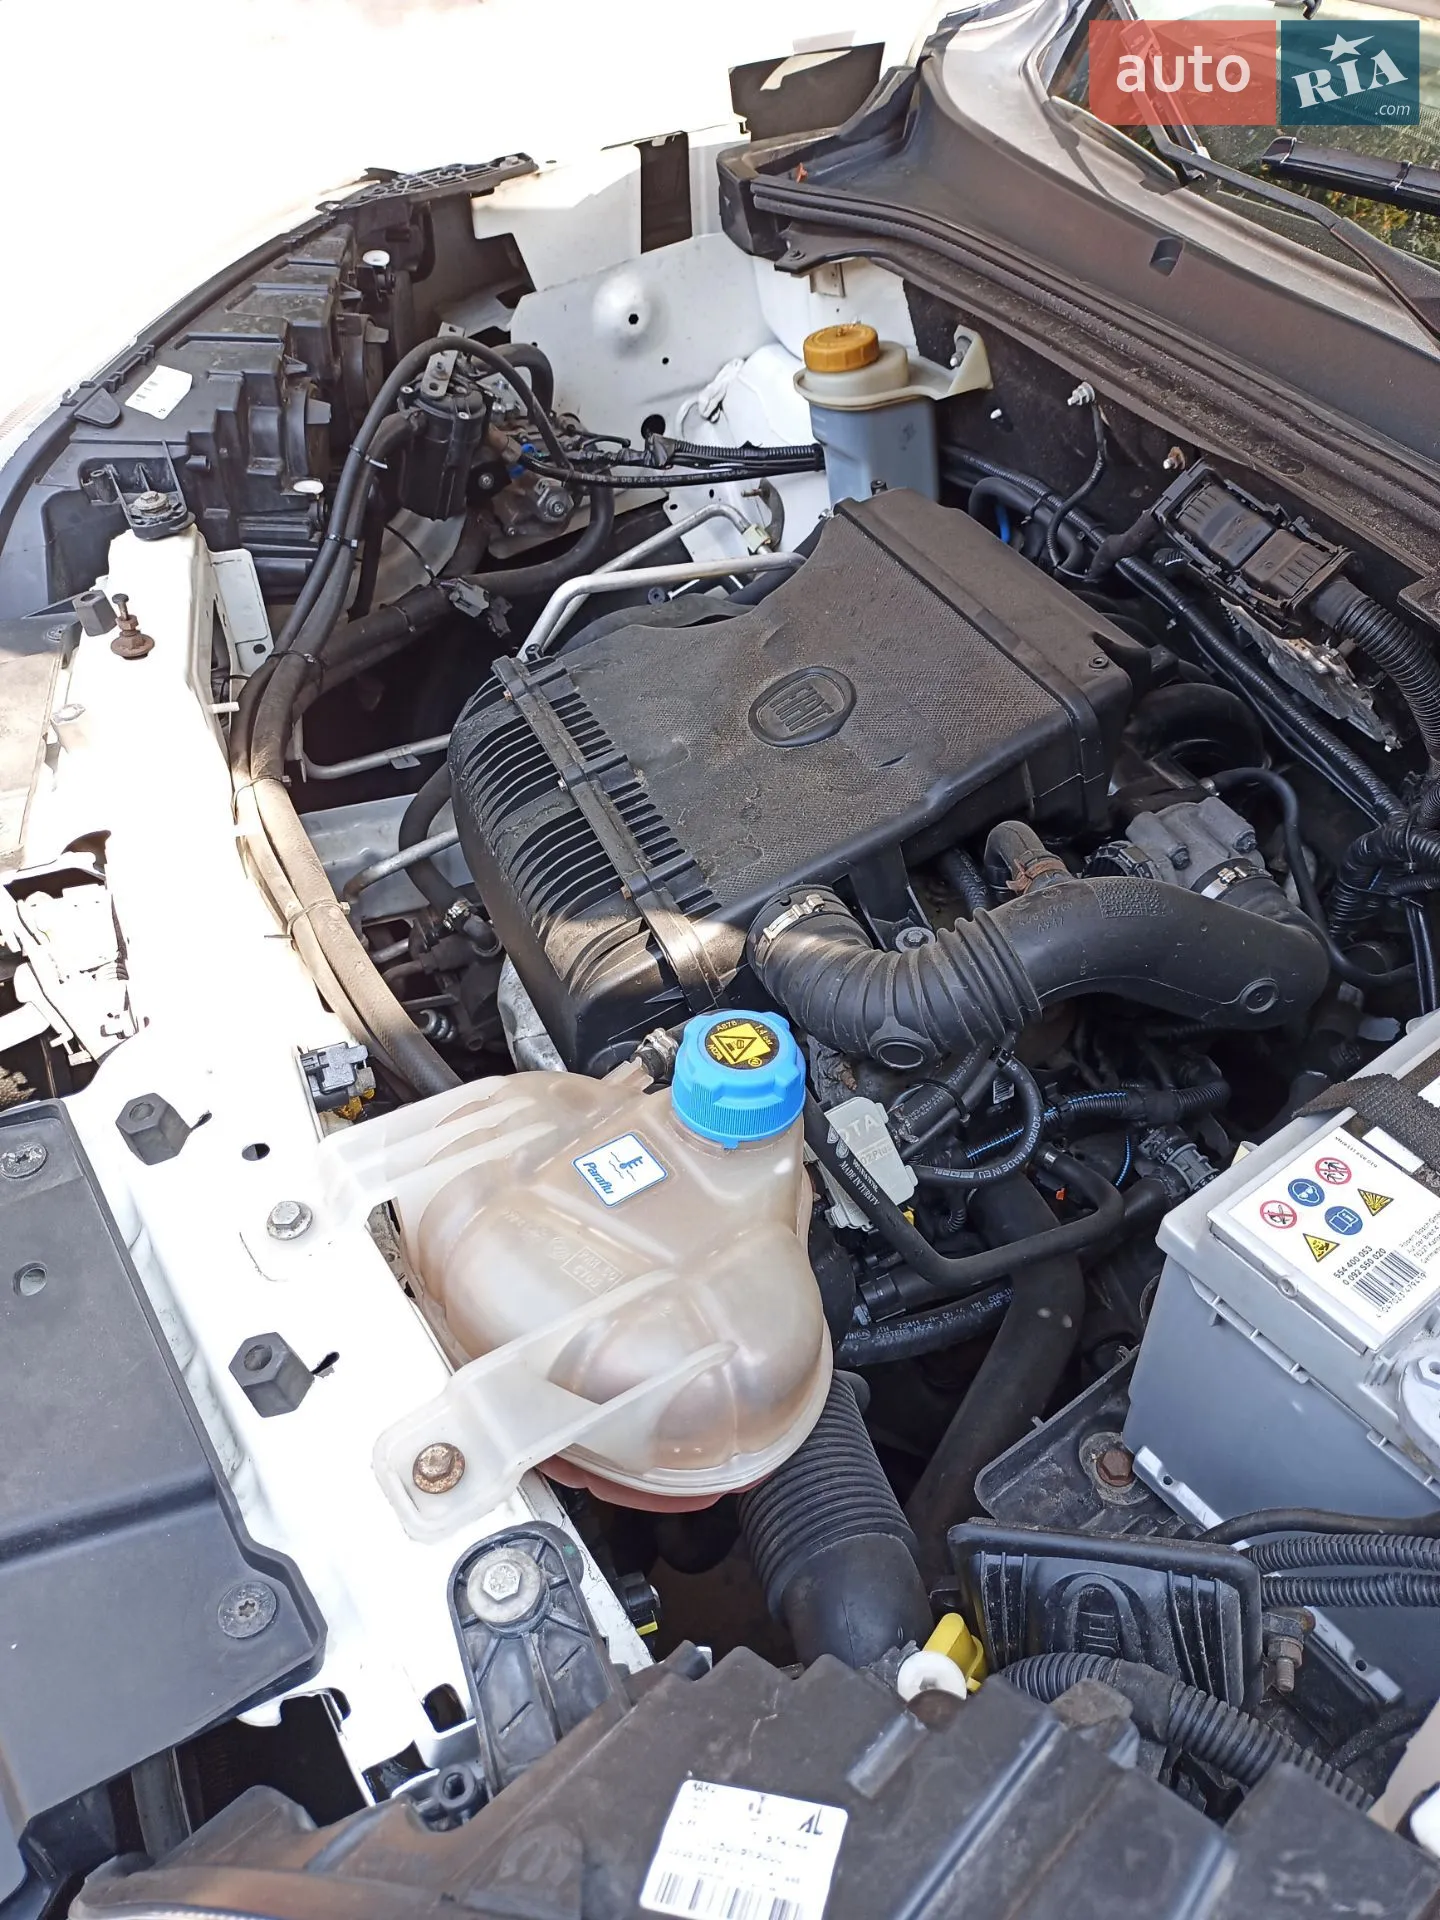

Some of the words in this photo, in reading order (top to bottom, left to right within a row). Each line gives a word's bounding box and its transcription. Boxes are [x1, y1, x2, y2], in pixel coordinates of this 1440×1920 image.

[769, 681, 836, 733] FIAT
[839, 1160, 856, 1180] MADE
[978, 1171, 992, 1179] EU
[992, 1167, 1002, 1177] IN
[1002, 1152, 1026, 1173] MADE
[583, 1162, 614, 1194] Paraflu
[1333, 1266, 1348, 1279] 554
[1346, 1256, 1360, 1268] 400
[1358, 1245, 1373, 1258] 053
[1348, 1269, 1362, 1281] 092
[1372, 1248, 1387, 1260] 020
